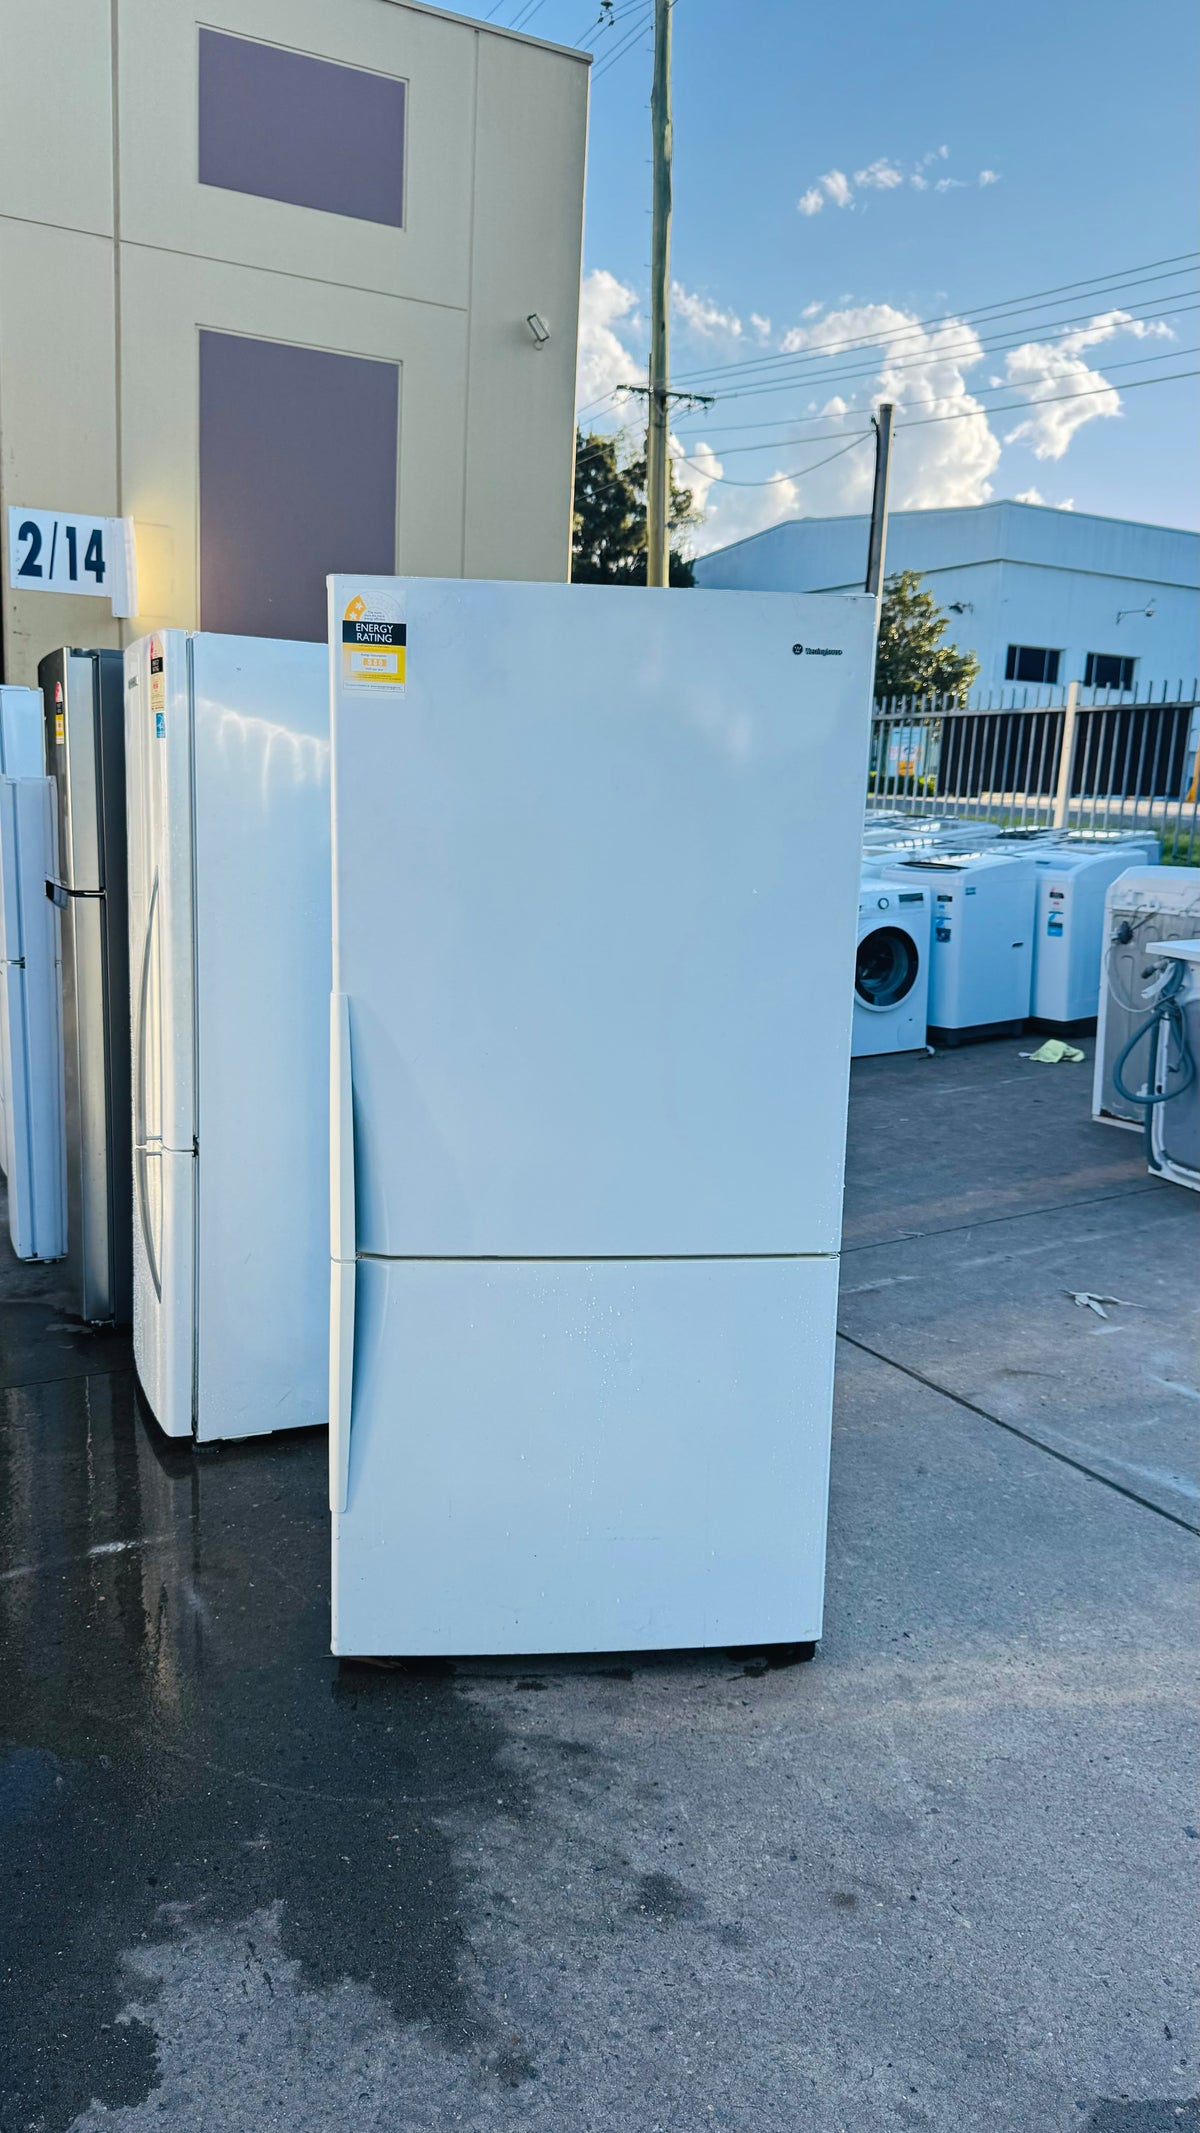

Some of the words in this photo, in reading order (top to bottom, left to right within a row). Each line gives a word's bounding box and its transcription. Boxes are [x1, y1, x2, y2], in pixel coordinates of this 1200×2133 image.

[18, 521, 106, 583] 2/14
[355, 623, 394, 633] ENERGY
[356, 633, 393, 643] RATING
